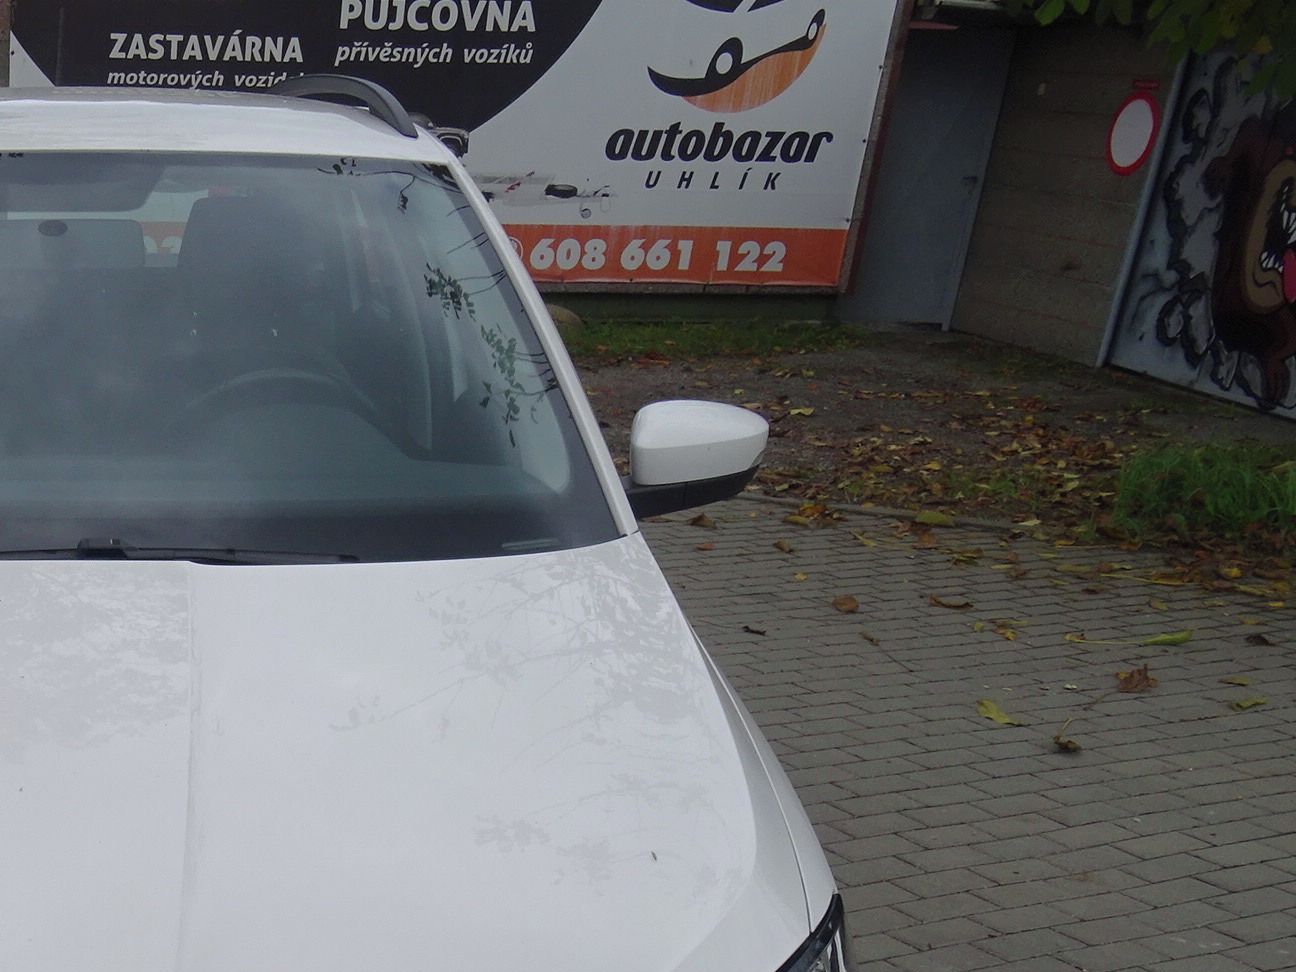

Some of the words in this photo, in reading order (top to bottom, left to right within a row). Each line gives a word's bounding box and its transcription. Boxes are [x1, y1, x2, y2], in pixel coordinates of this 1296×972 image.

[109, 30, 303, 62] ZASTAVÁRNA
[334, 42, 453, 68] přívěsných
[463, 43, 534, 64] vozíků
[107, 70, 224, 91] motorových
[605, 121, 833, 162] autobazar
[645, 168, 782, 190] UHLÍK
[529, 238, 608, 271] 608
[620, 238, 694, 271] 661
[716, 240, 787, 272] 122
